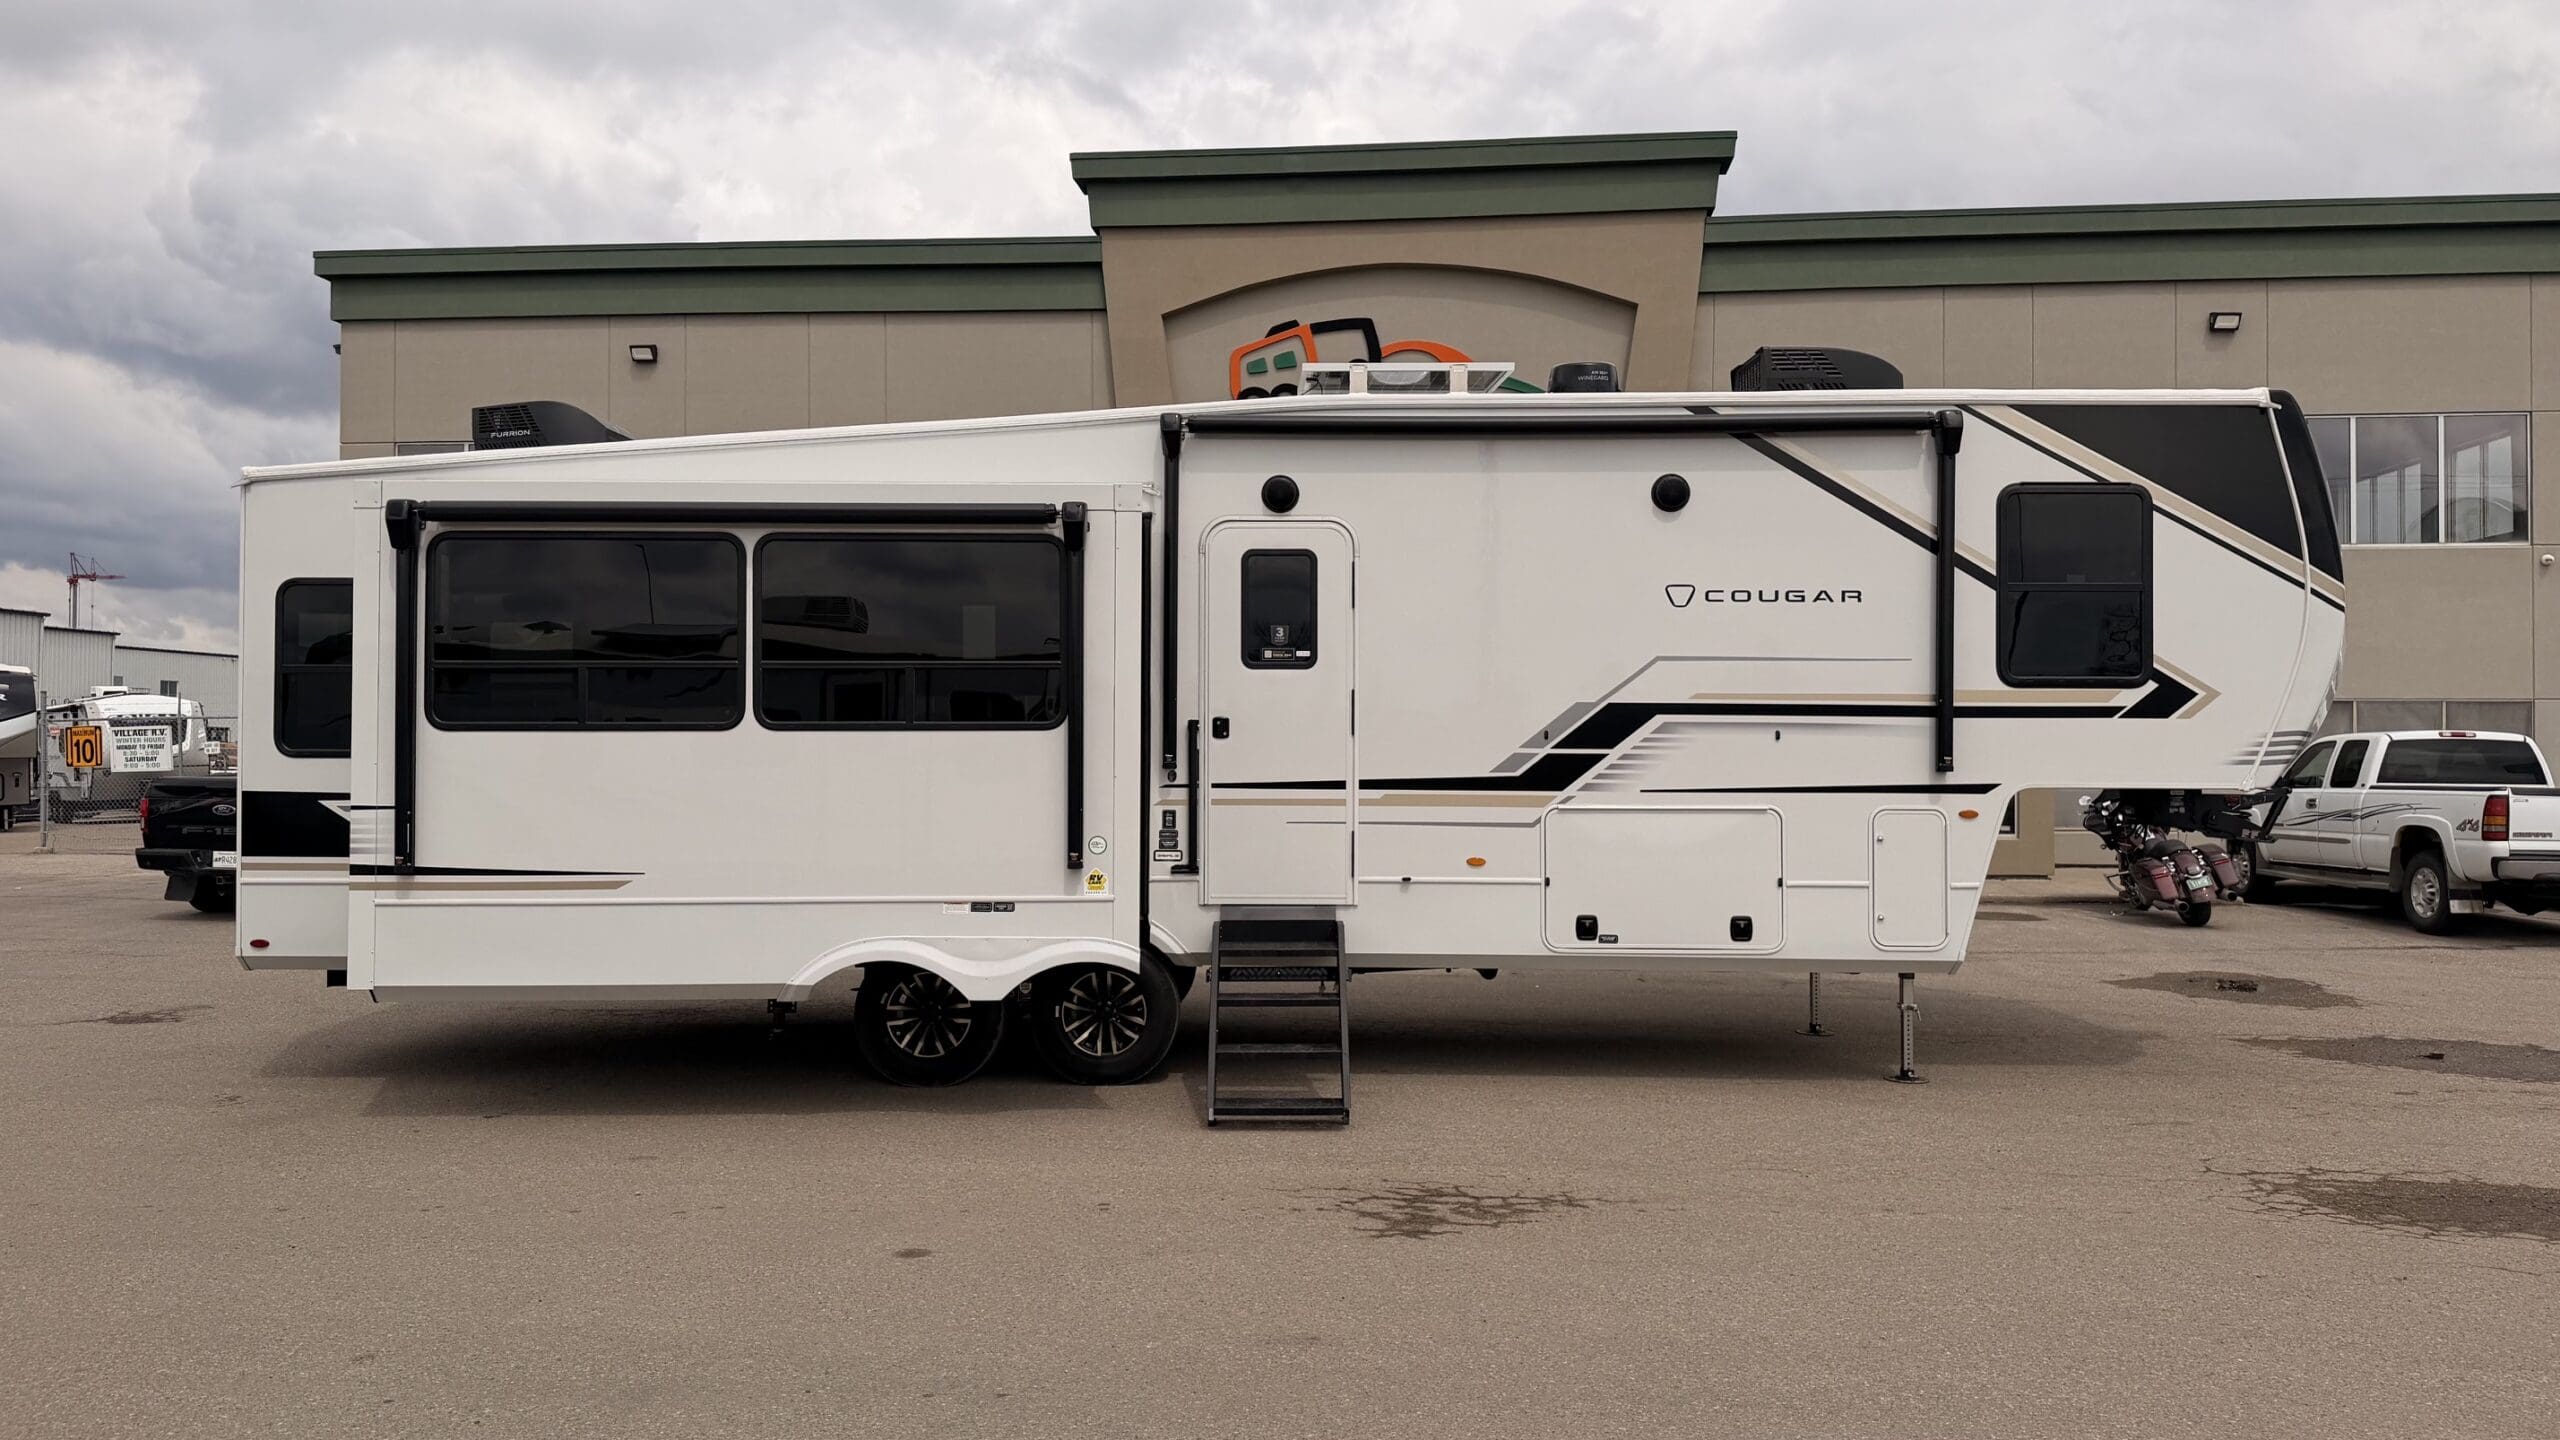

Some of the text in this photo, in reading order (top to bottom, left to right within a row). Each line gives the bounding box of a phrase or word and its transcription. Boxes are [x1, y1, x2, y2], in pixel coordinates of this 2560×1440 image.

[490, 430, 530, 438] FURRION
[1704, 589, 1863, 603] COUGAR
[1275, 627, 1285, 637] 3
[113, 728, 168, 737] VILLAGE R.V.
[74, 739, 95, 764] 10
